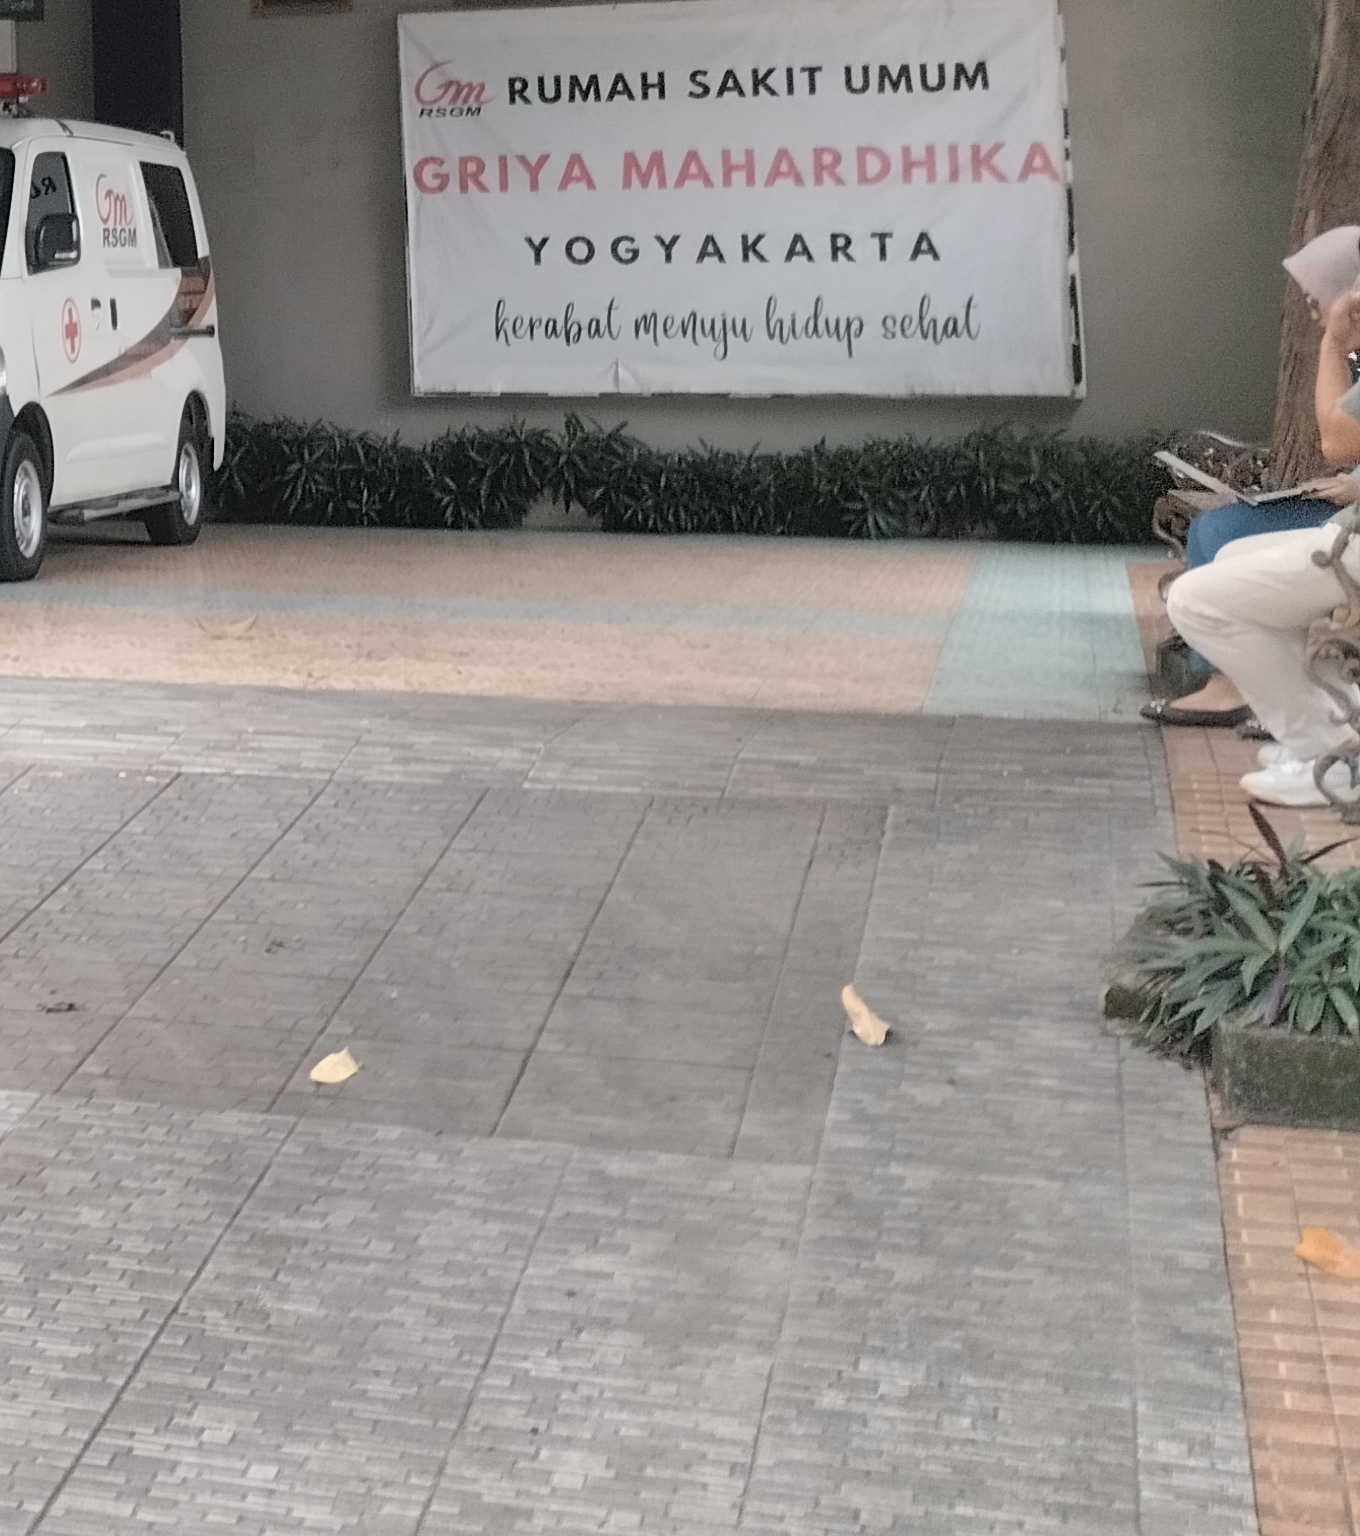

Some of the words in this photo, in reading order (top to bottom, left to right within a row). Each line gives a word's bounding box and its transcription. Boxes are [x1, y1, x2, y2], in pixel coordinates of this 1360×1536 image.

[507, 71, 667, 106] RUMAH
[687, 66, 823, 99] SAKIT
[843, 61, 990, 94] UMUM
[418, 106, 482, 119] RSGM
[412, 153, 598, 195] GRIYA
[622, 141, 1060, 191] MAHARDHIKA
[103, 227, 138, 248] RSGM
[524, 232, 942, 265] YOGYAKARTA
[494, 297, 622, 346] kerabat
[634, 310, 754, 360] menuju
[765, 293, 865, 359] hidup
[881, 293, 981, 345] sehat
